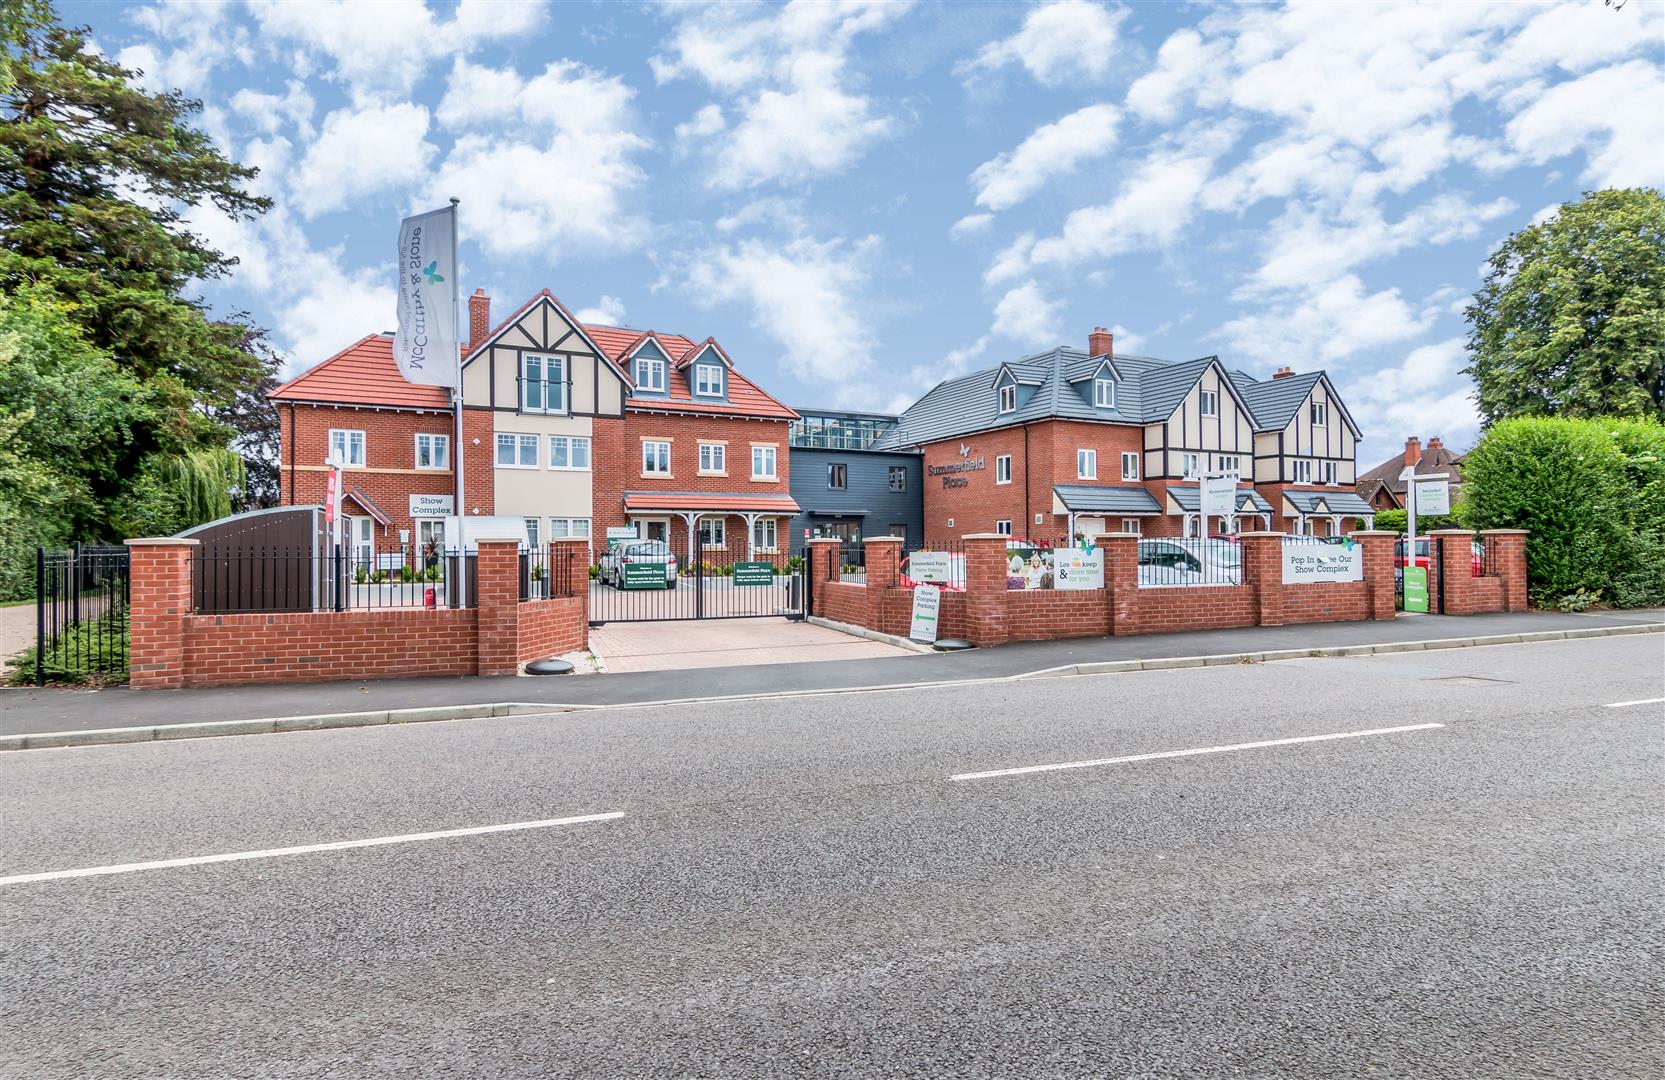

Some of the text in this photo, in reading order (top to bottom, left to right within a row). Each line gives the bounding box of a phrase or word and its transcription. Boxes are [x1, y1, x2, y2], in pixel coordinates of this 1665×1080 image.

[928, 457, 985, 476] Summerfield
[942, 477, 968, 489] Place
[412, 506, 451, 514] Complex
[1291, 556, 1305, 565] Pop
[1060, 569, 1068, 579] &
[1316, 565, 1349, 574] Complex
